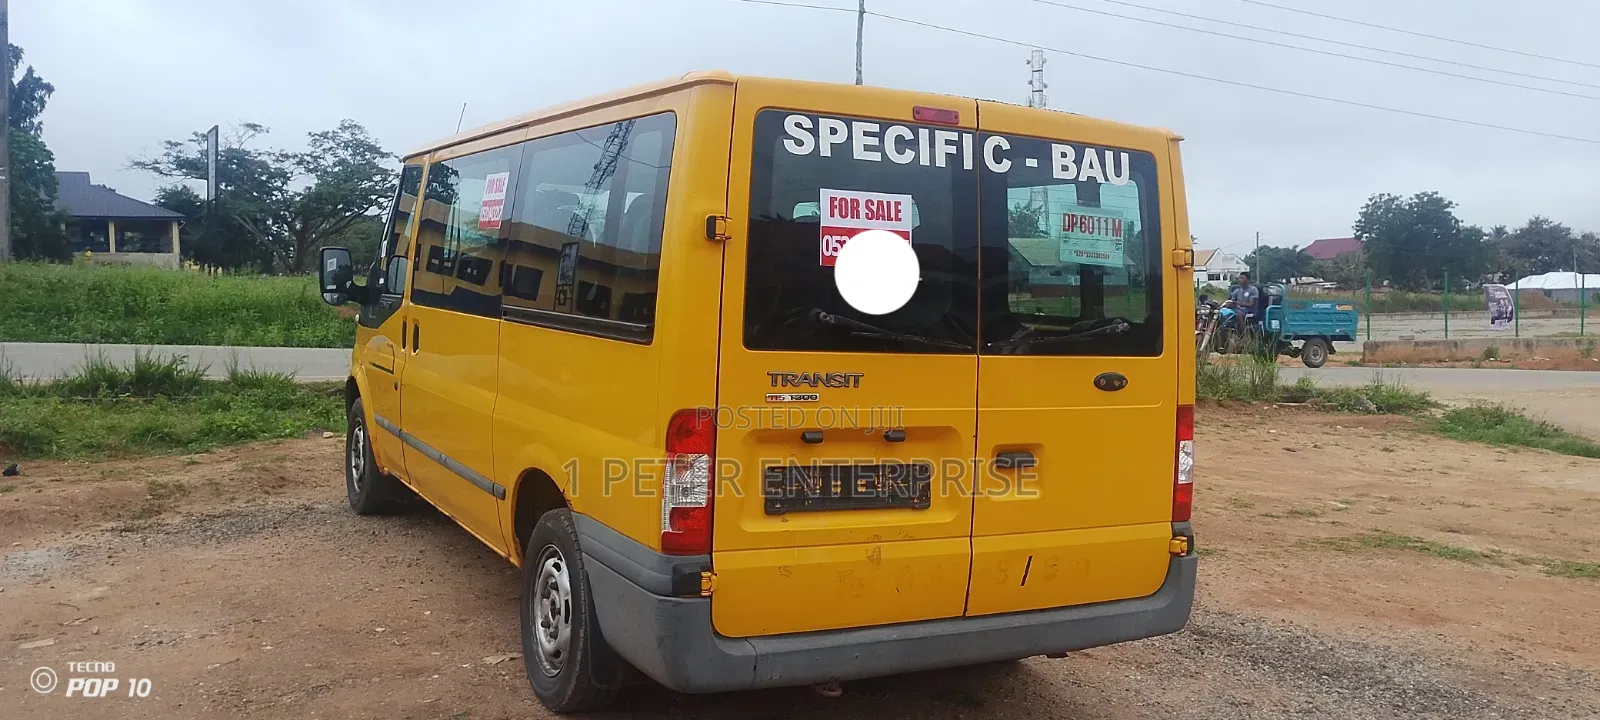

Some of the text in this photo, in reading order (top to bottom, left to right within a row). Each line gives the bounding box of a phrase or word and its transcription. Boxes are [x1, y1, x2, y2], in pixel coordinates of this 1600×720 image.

[1052, 143, 1130, 186] BAU
[829, 196, 902, 222] FOR SALE
[767, 371, 864, 388] TRANSIT
